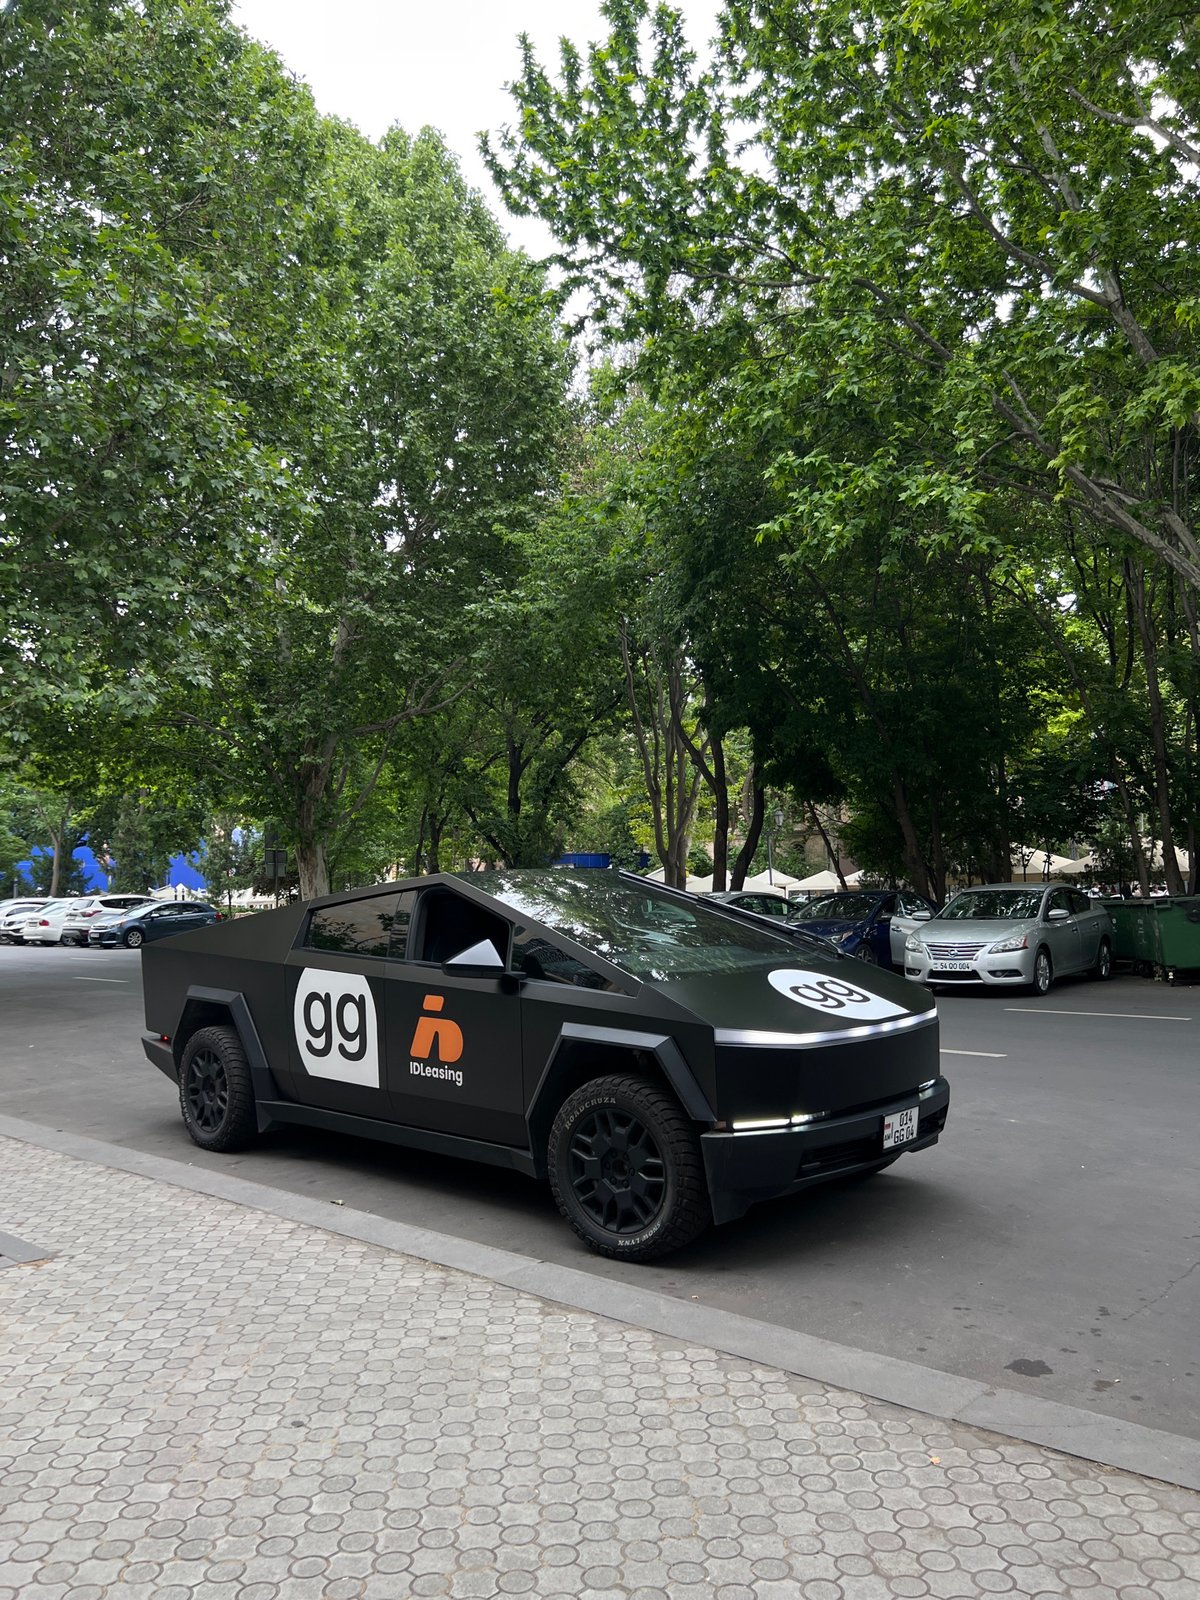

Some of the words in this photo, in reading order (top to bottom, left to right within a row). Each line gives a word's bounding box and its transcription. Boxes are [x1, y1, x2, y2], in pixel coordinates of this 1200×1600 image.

[789, 979, 871, 1009] gg
[303, 991, 367, 1061] gg
[409, 1061, 463, 1087] IDLeasing
[565, 1097, 616, 1130] ROADCRUZA
[899, 1110, 913, 1127] 014
[893, 1128, 905, 1144] GG
[905, 1125, 915, 1140] 04
[617, 1237, 641, 1246] LYNX
[642, 1222, 661, 1242] SNOW
